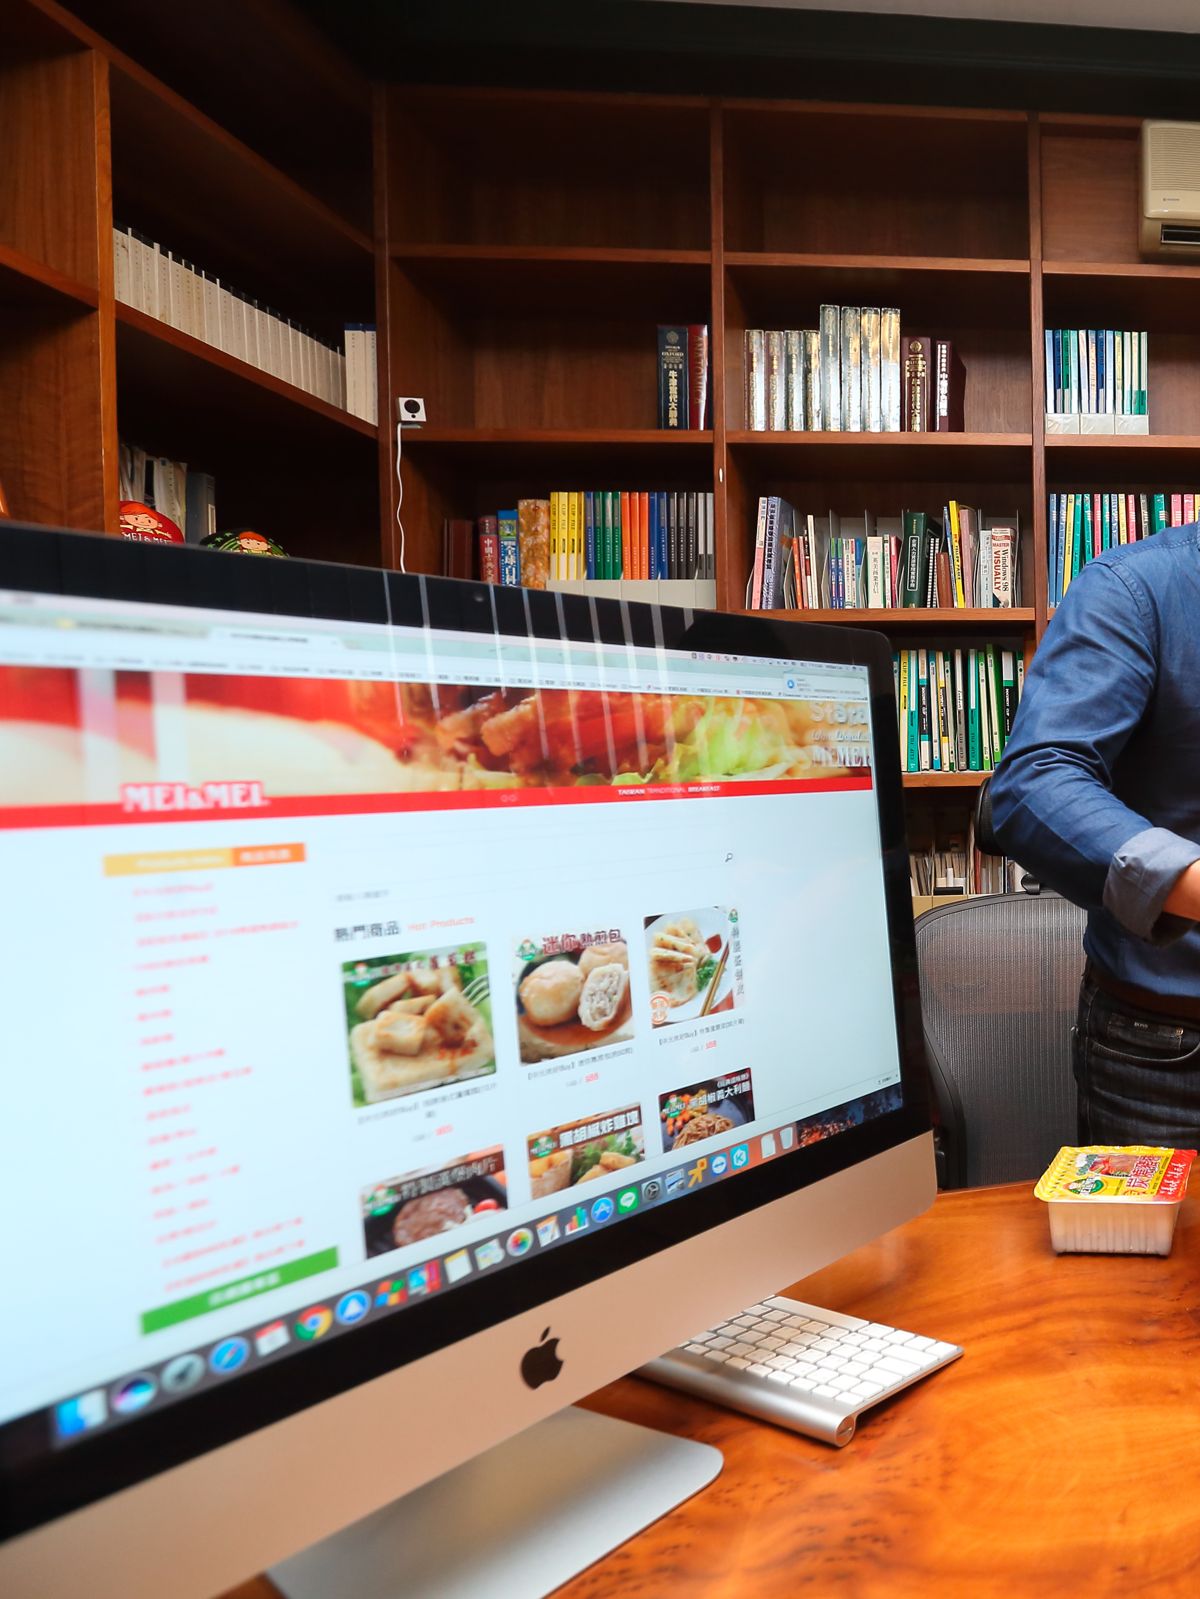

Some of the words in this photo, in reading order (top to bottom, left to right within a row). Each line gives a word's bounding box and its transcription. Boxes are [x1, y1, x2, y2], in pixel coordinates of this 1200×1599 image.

[1002, 582, 1009, 592] 98
[334, 920, 401, 942] 熱門商品
